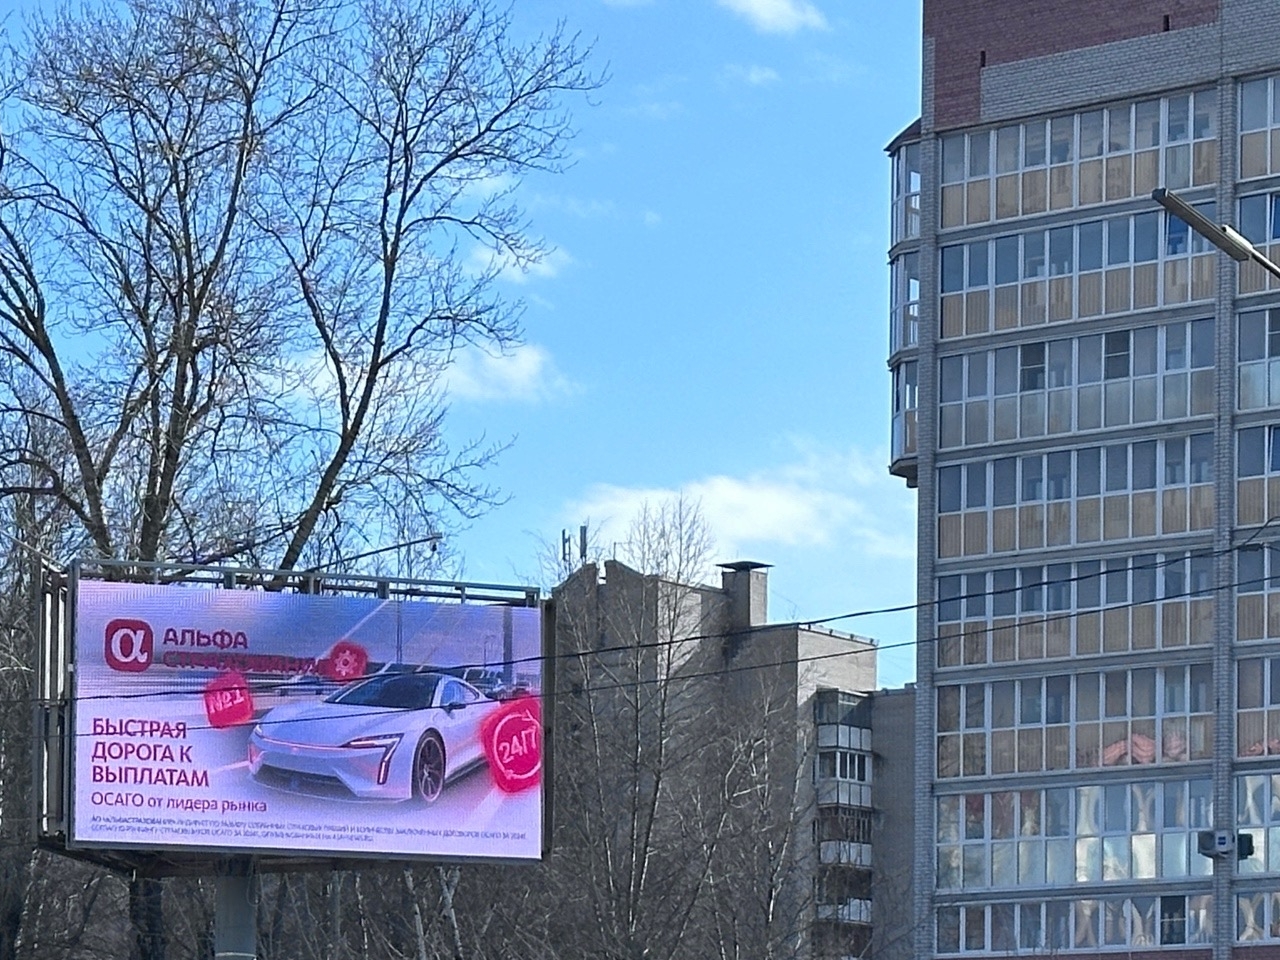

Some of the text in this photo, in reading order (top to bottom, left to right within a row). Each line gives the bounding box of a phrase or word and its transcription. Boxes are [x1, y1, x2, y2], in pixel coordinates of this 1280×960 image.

[162, 627, 249, 650] АЛЬФА
[92, 717, 188, 739] БЫСТРАЯ
[91, 741, 193, 763] ДОРОГА К
[92, 765, 210, 788] ВЫПЛАТАМ
[91, 791, 268, 814] ОСАГО от лидера рынка
